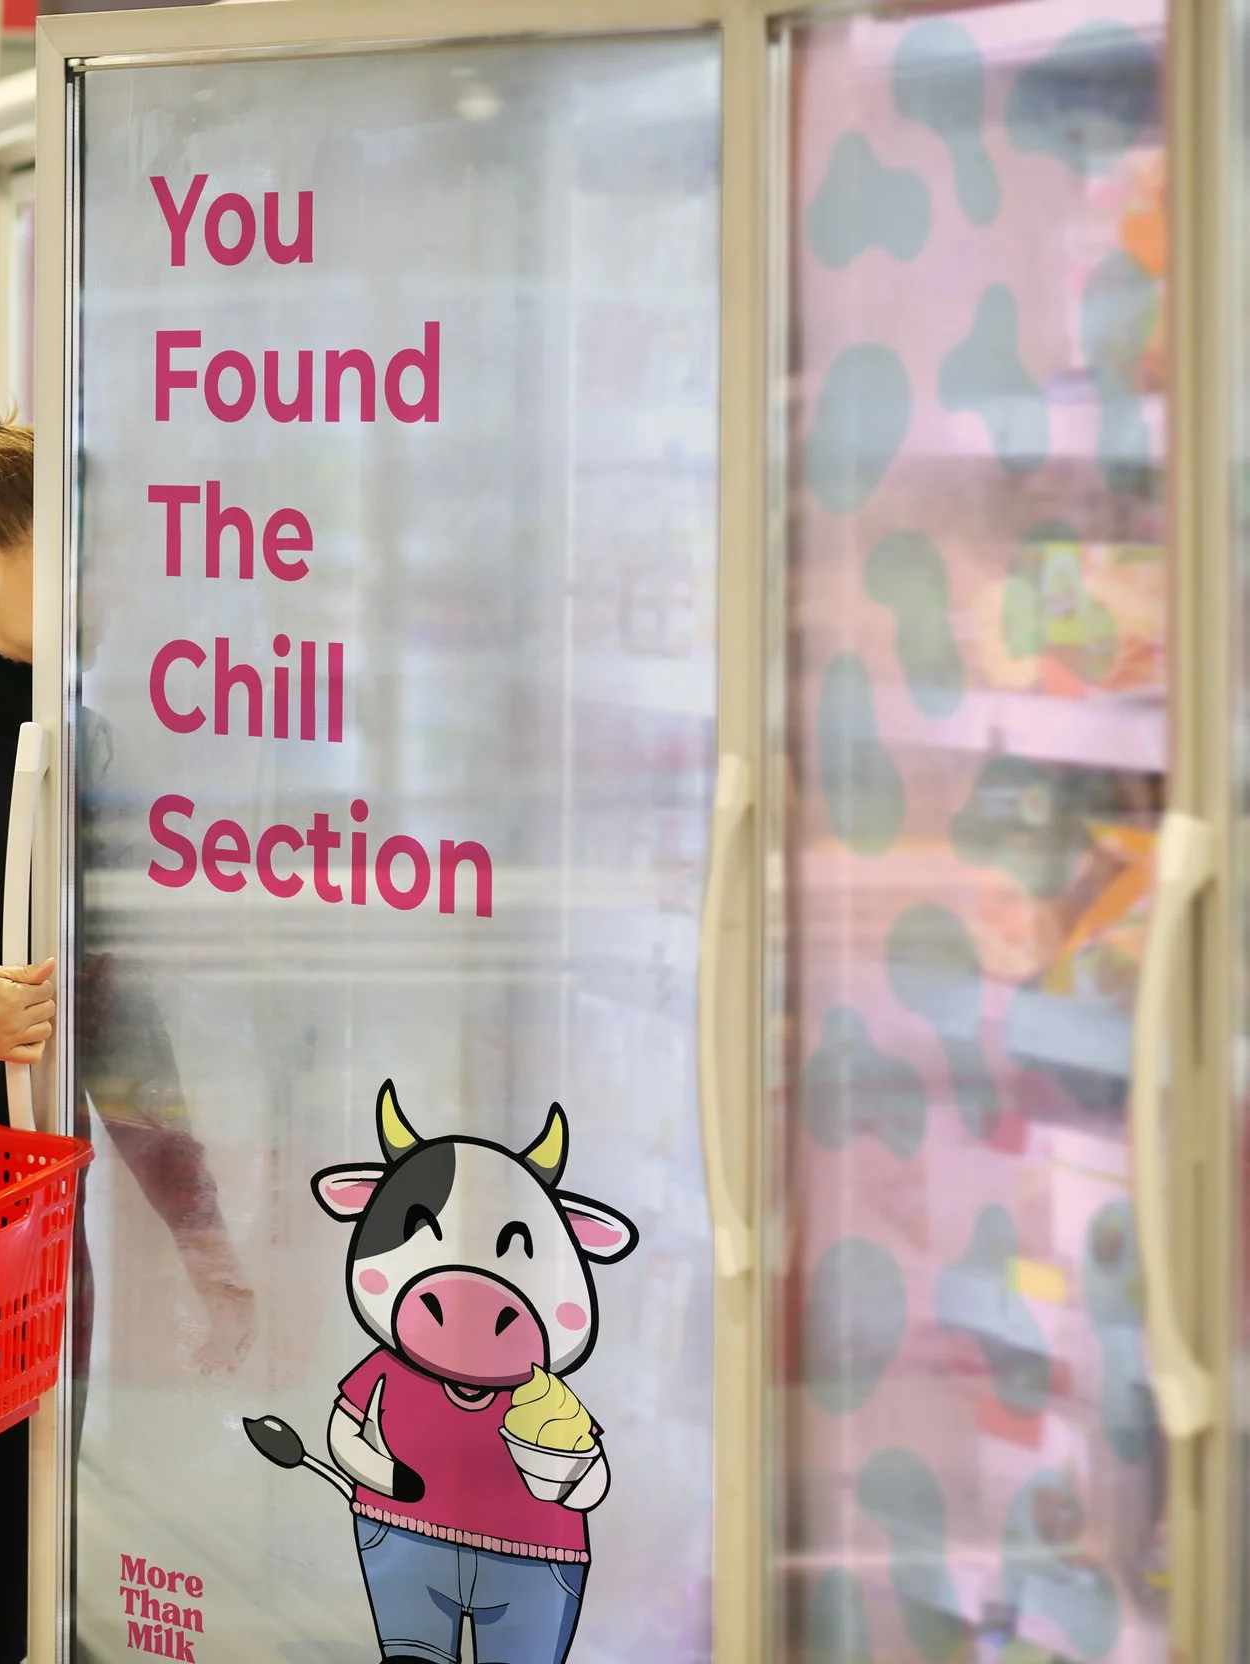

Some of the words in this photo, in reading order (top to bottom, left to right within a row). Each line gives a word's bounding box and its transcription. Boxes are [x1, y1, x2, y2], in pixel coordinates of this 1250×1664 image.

[149, 174, 313, 267] You
[154, 321, 440, 424] Found
[147, 480, 313, 582] The
[149, 633, 344, 743] Chill
[147, 794, 493, 918] Section
[119, 1585, 204, 1633] Than
[120, 1553, 204, 1599] More
[127, 1620, 196, 1664] Milk
